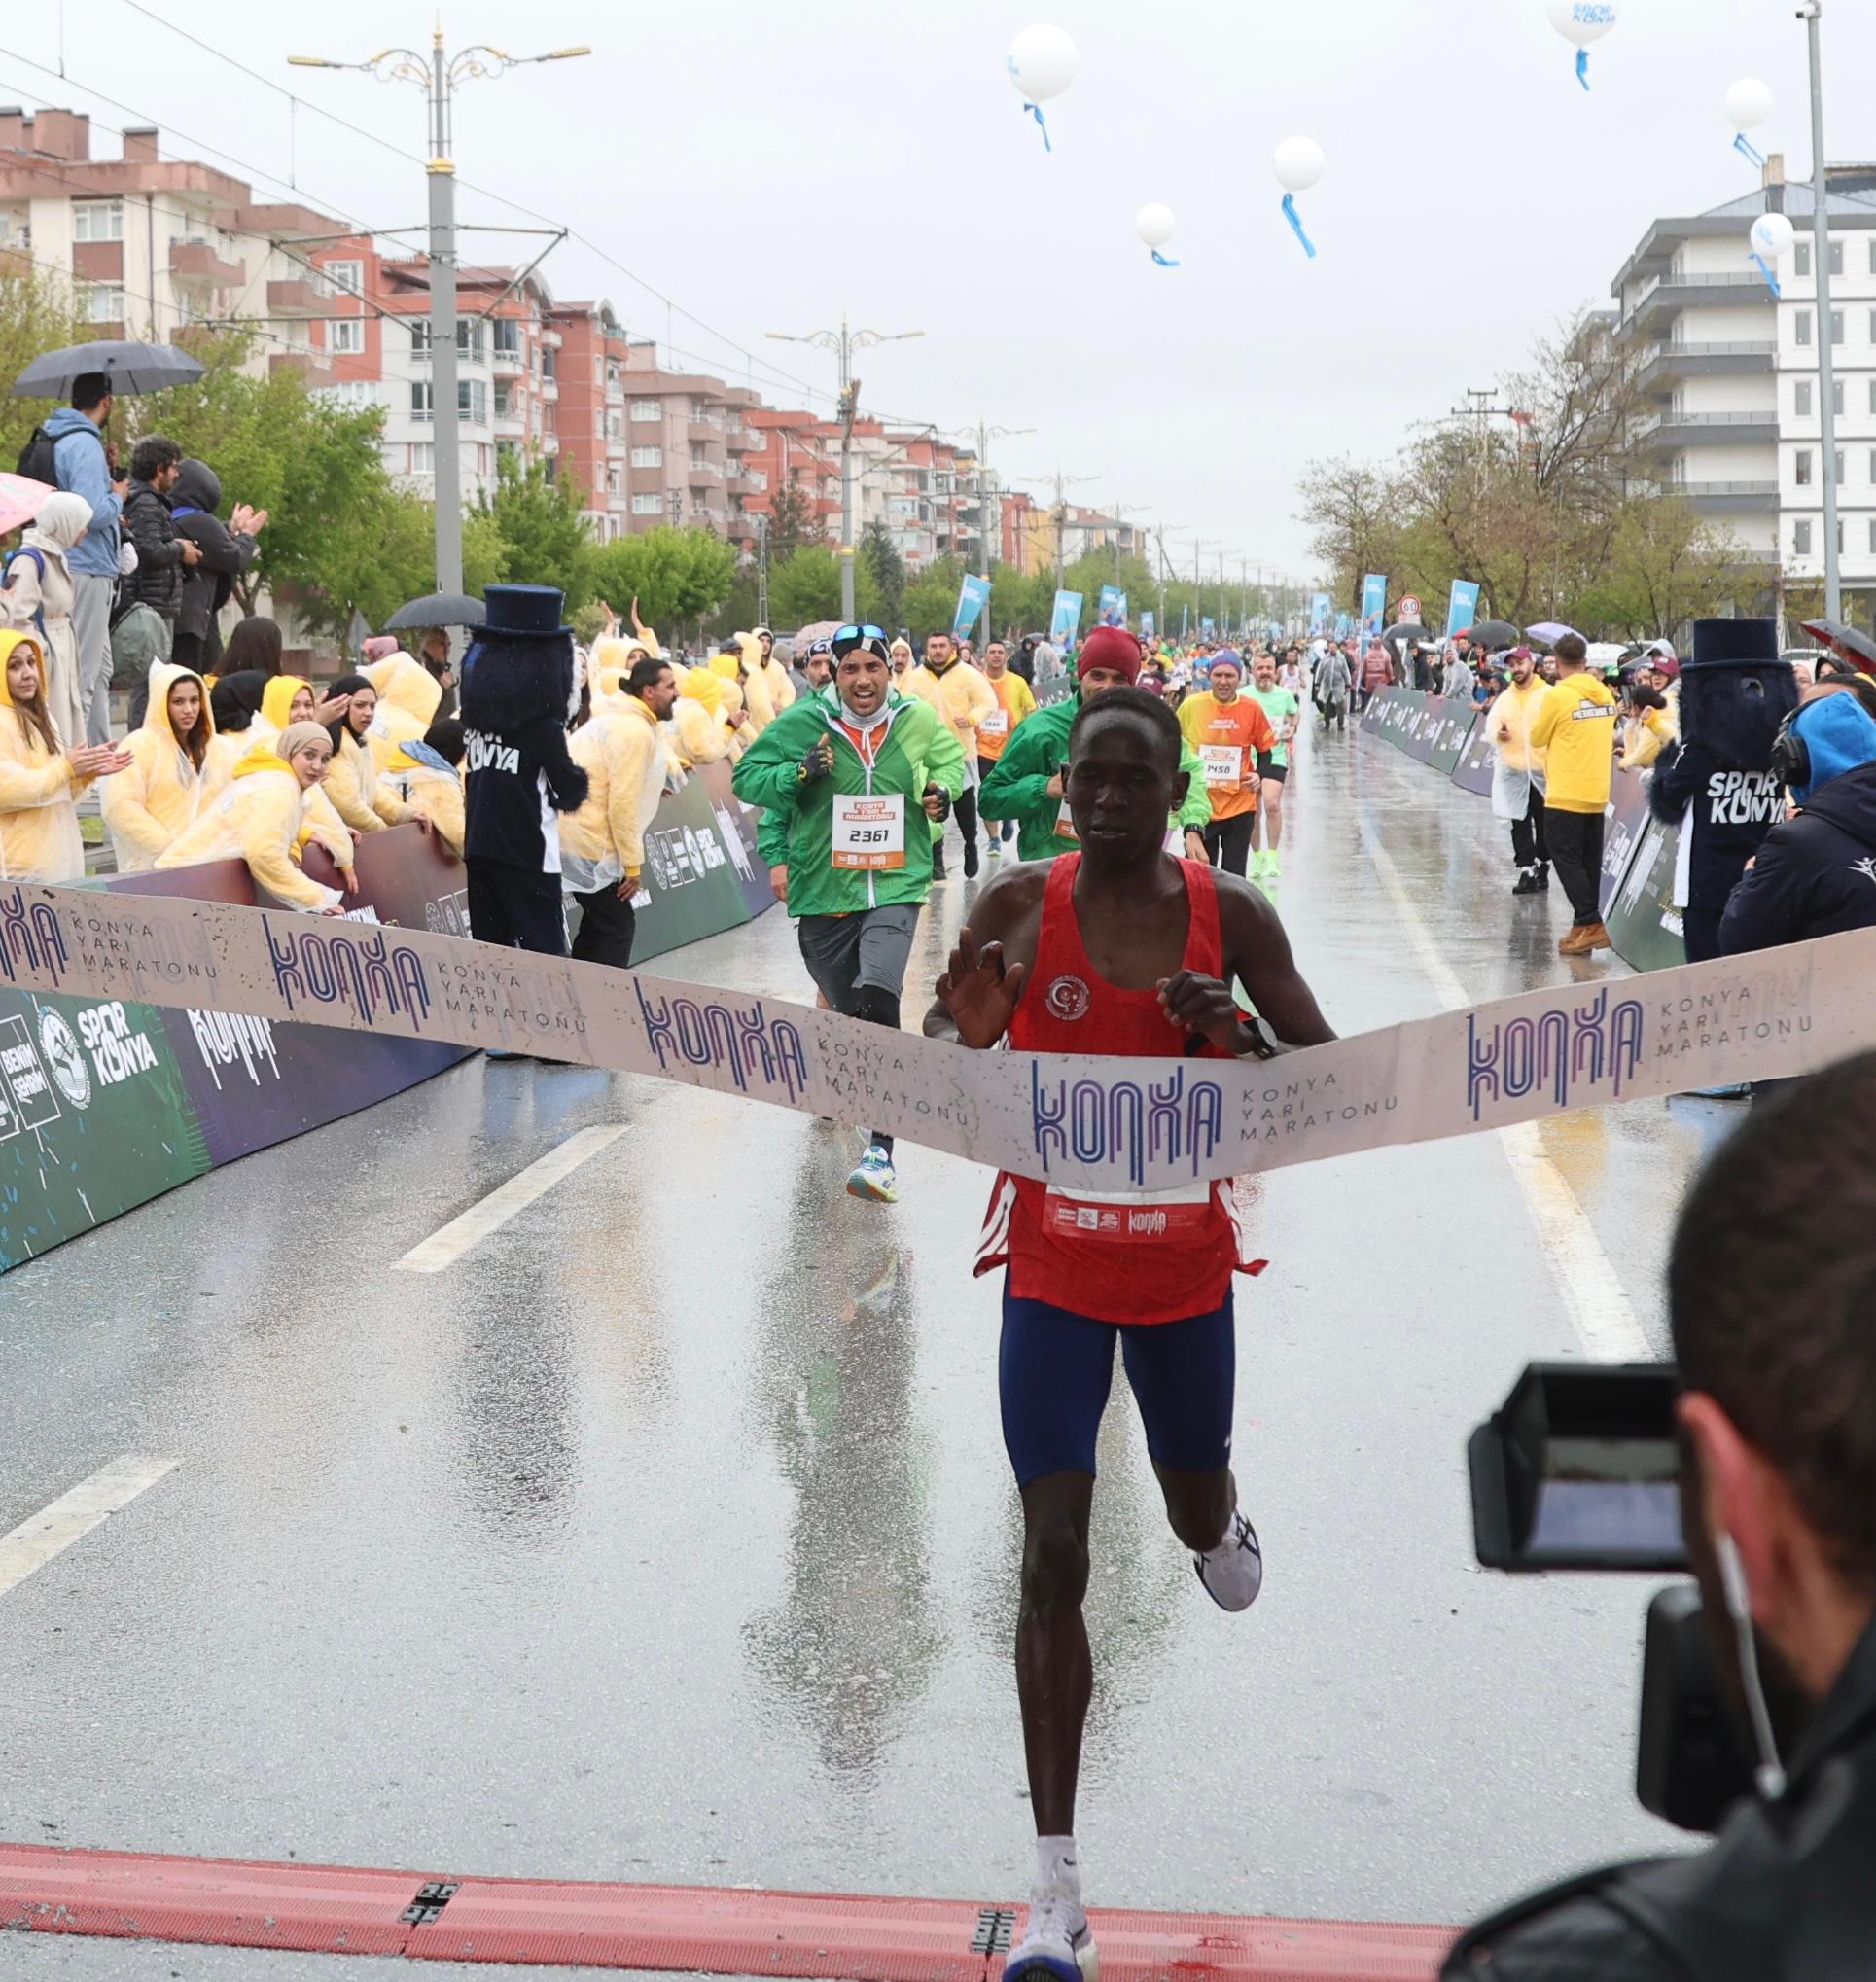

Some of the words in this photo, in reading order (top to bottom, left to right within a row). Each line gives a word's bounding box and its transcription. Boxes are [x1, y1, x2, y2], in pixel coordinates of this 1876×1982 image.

[1403, 601, 1417, 612] 60
[466, 736, 520, 775] ONYA
[1706, 770, 1780, 797] SPOR
[849, 829, 889, 842] 2361
[73, 917, 153, 938] KONYA
[78, 936, 130, 952] YARI
[82, 954, 218, 979] MARATONU
[438, 962, 521, 987] KONYA
[442, 981, 499, 1001] YARI
[1661, 987, 1752, 1017] KONYA
[77, 1001, 130, 1049] SPOR
[445, 999, 587, 1033] MARATONU
[1661, 1012, 1719, 1037] YARI
[1655, 1016, 1813, 1056] MARATONU
[91, 1031, 159, 1086] KONYA
[818, 1037, 905, 1072] KONYA
[822, 1057, 880, 1081] YARI
[825, 1075, 969, 1126] MARATONU
[1242, 1073, 1337, 1102] KONYA
[1240, 1096, 1399, 1141] MARATONU
[1241, 1101, 1305, 1121] YARI
